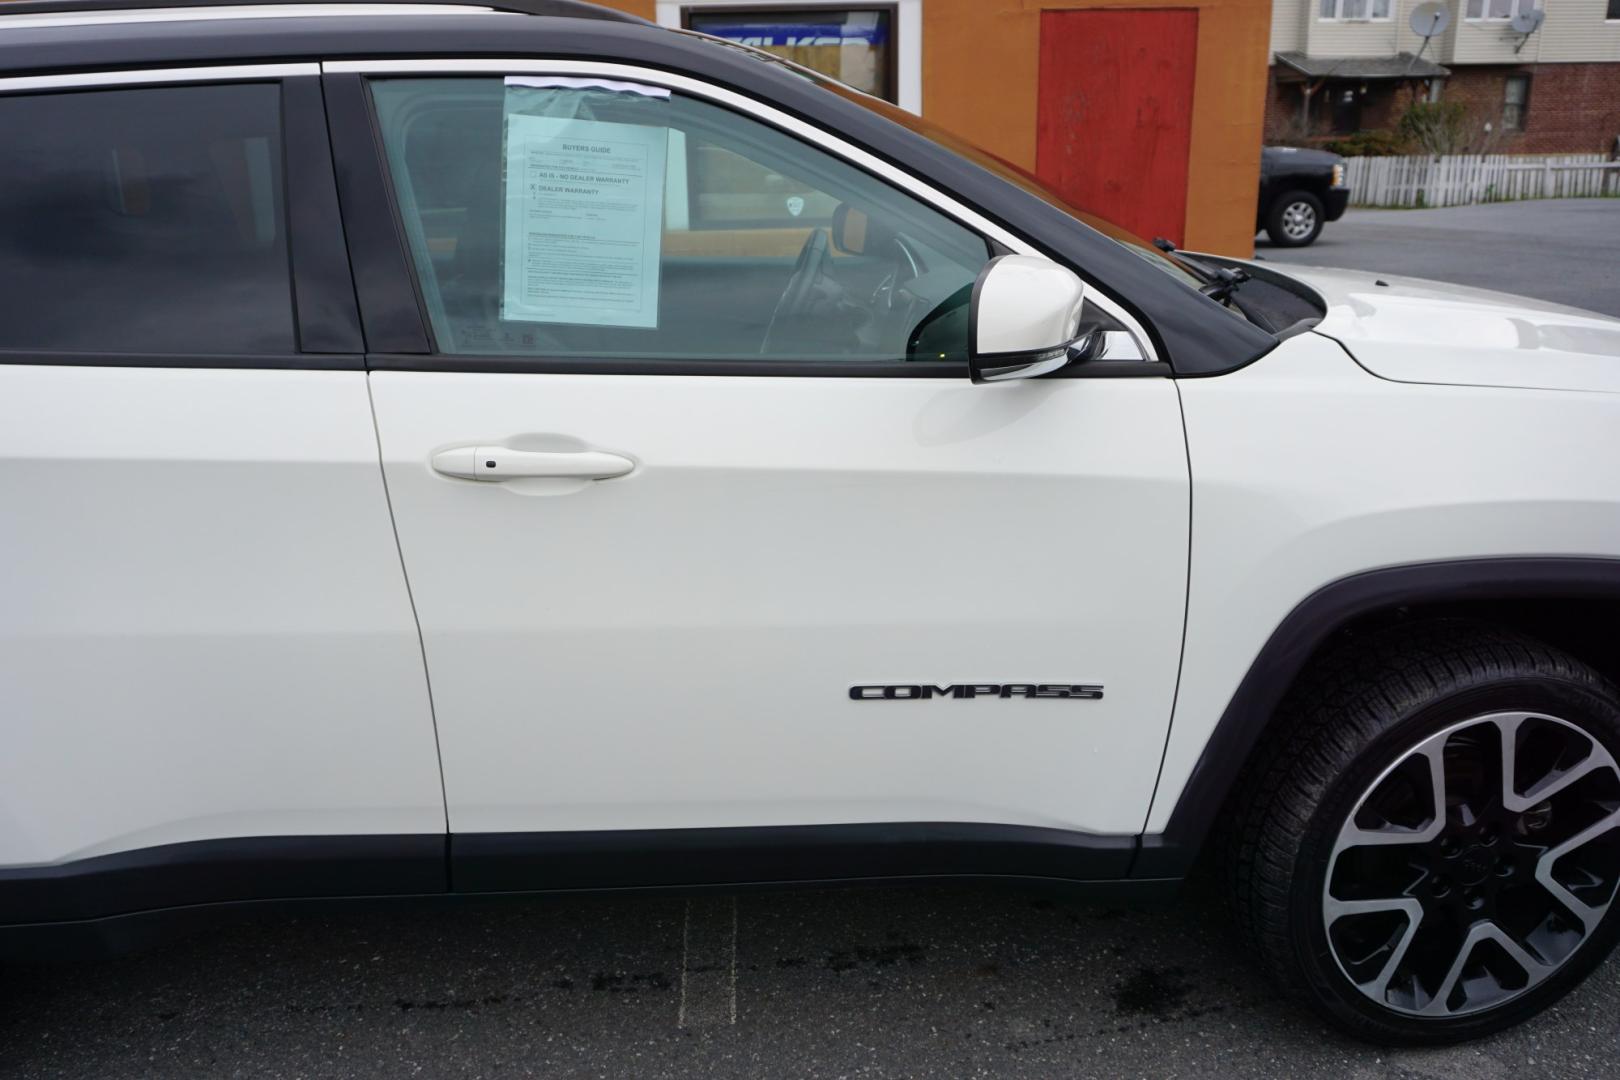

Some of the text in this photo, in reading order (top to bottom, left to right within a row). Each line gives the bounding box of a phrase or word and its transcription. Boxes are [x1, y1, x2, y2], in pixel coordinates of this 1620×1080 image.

[563, 144, 589, 152] BUYERS
[596, 177, 630, 185] WARRANTY
[849, 684, 1104, 701] COMPASS
